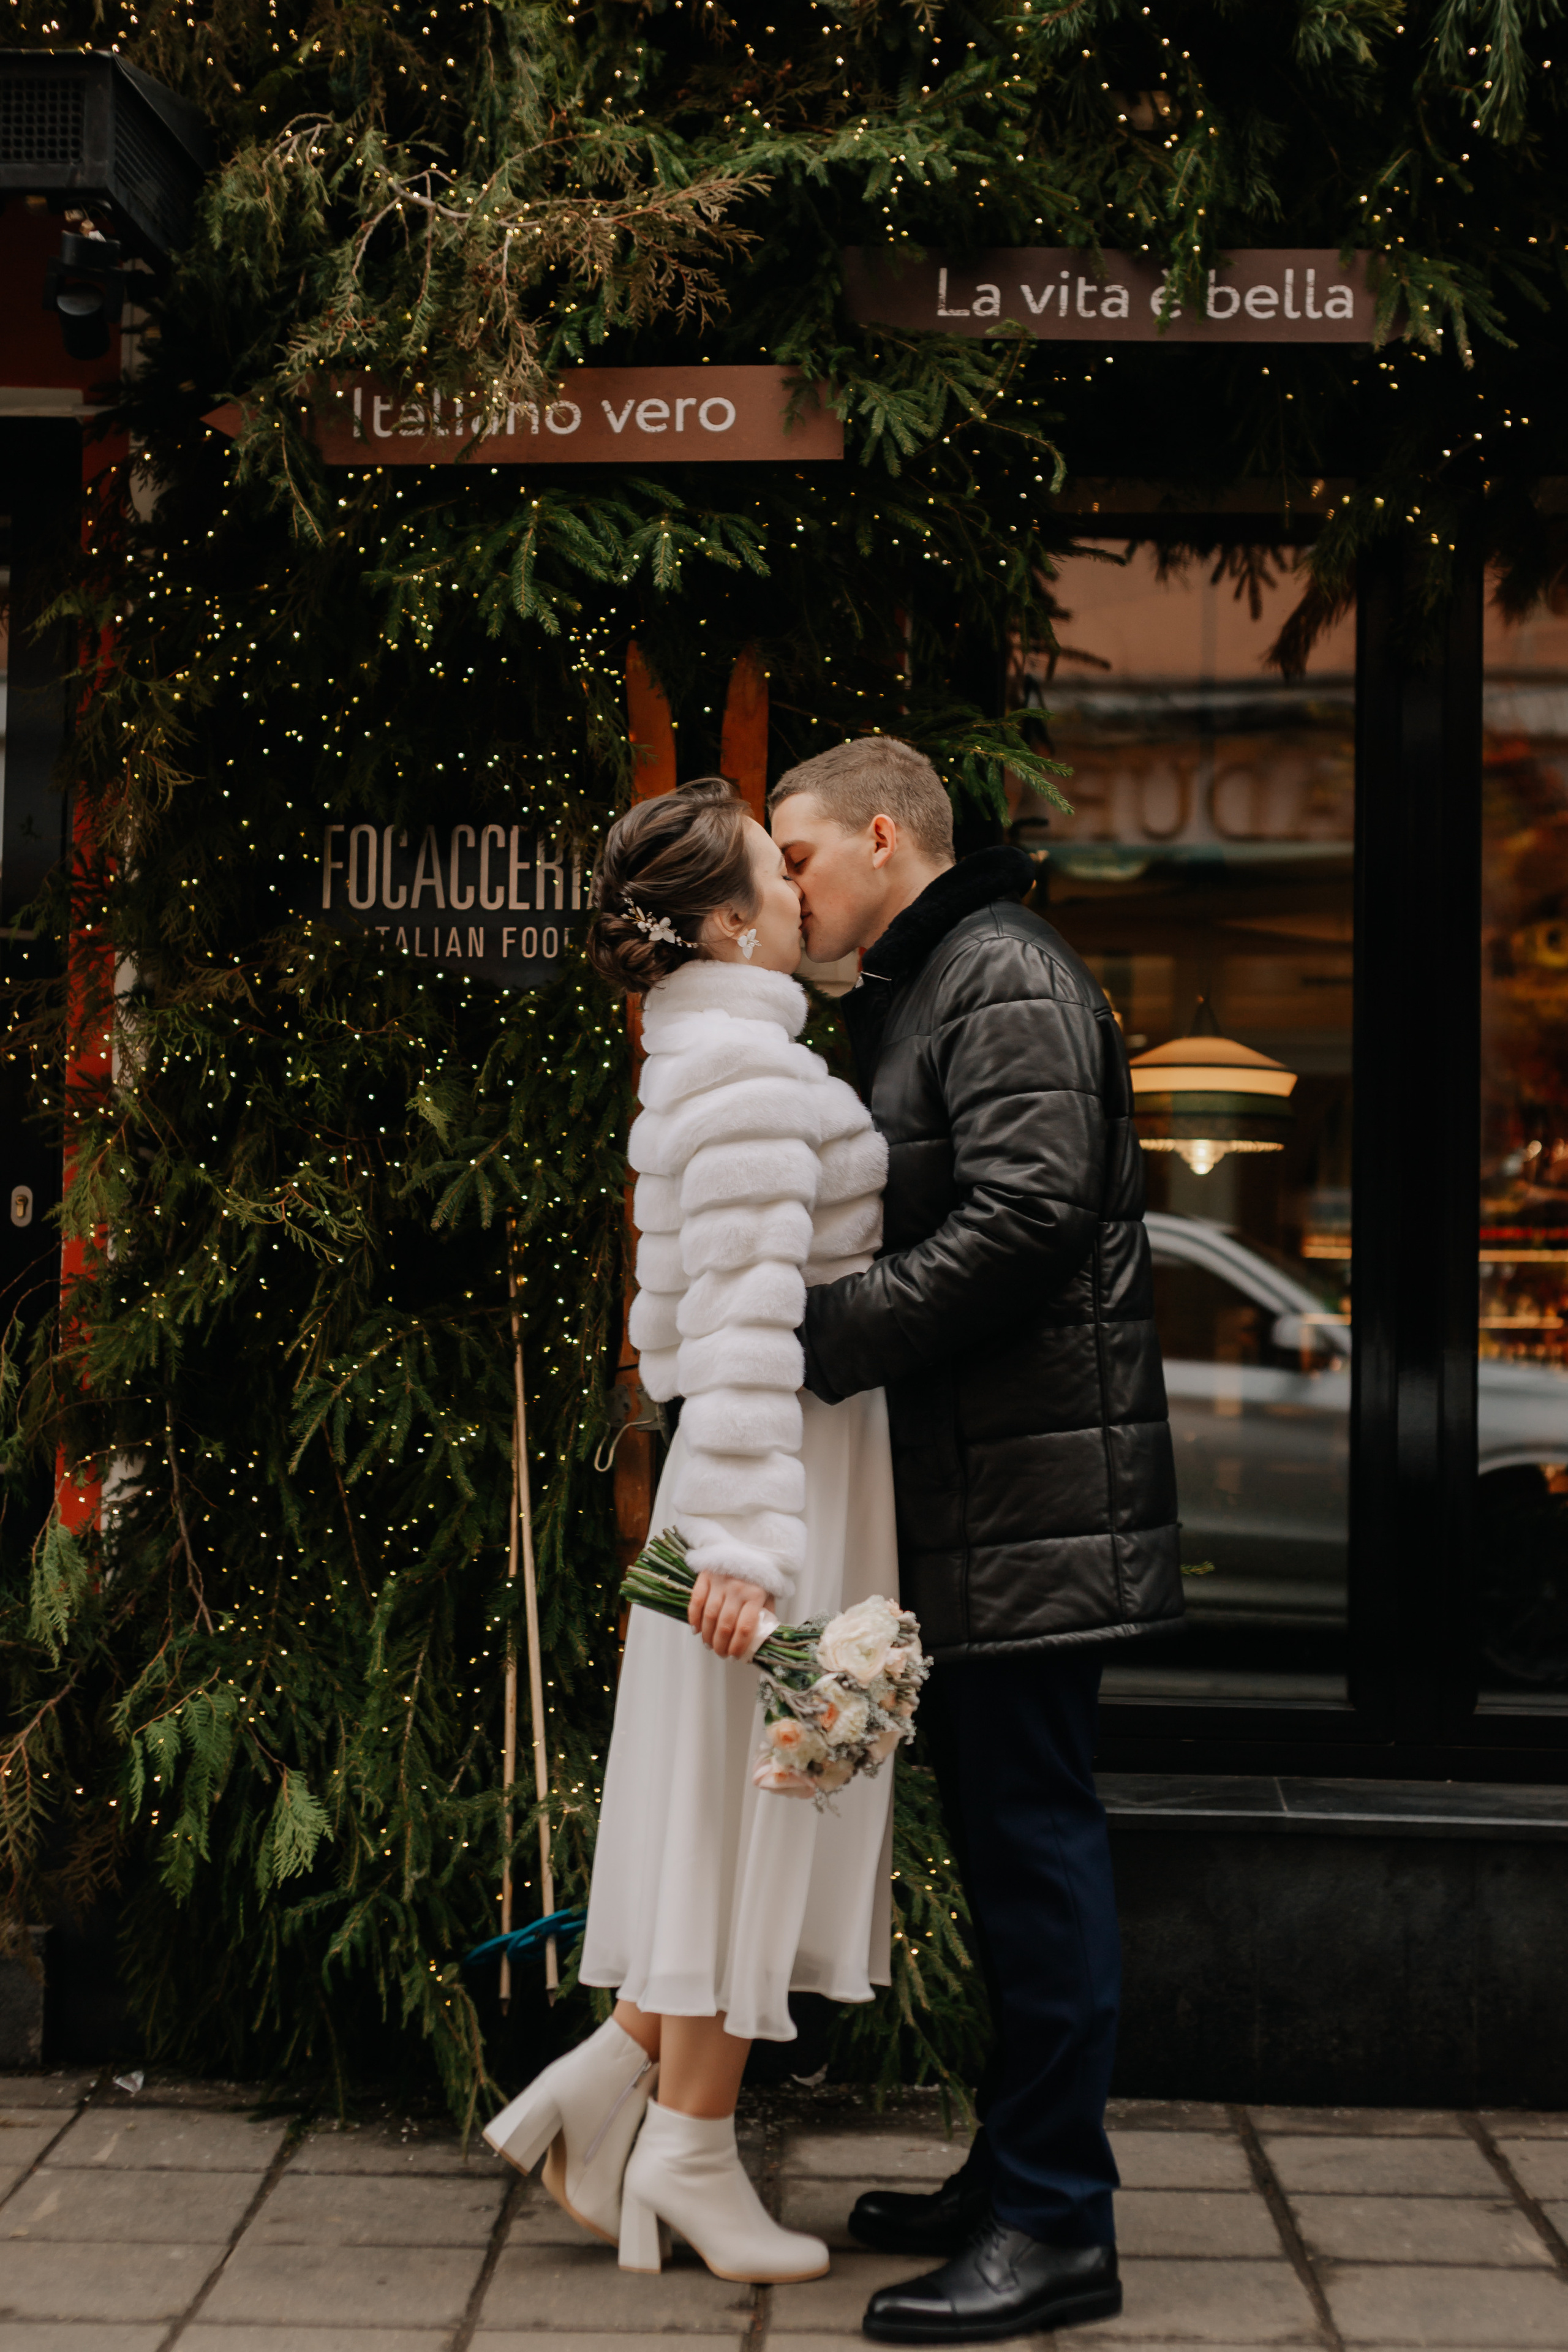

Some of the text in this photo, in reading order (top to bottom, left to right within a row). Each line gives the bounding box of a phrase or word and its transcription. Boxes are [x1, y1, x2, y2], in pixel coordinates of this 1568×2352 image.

[937, 267, 1001, 317] La
[1020, 270, 1129, 318] vita
[1206, 268, 1355, 319] bella
[601, 393, 736, 434] vero
[364, 926, 484, 958] TALIAN
